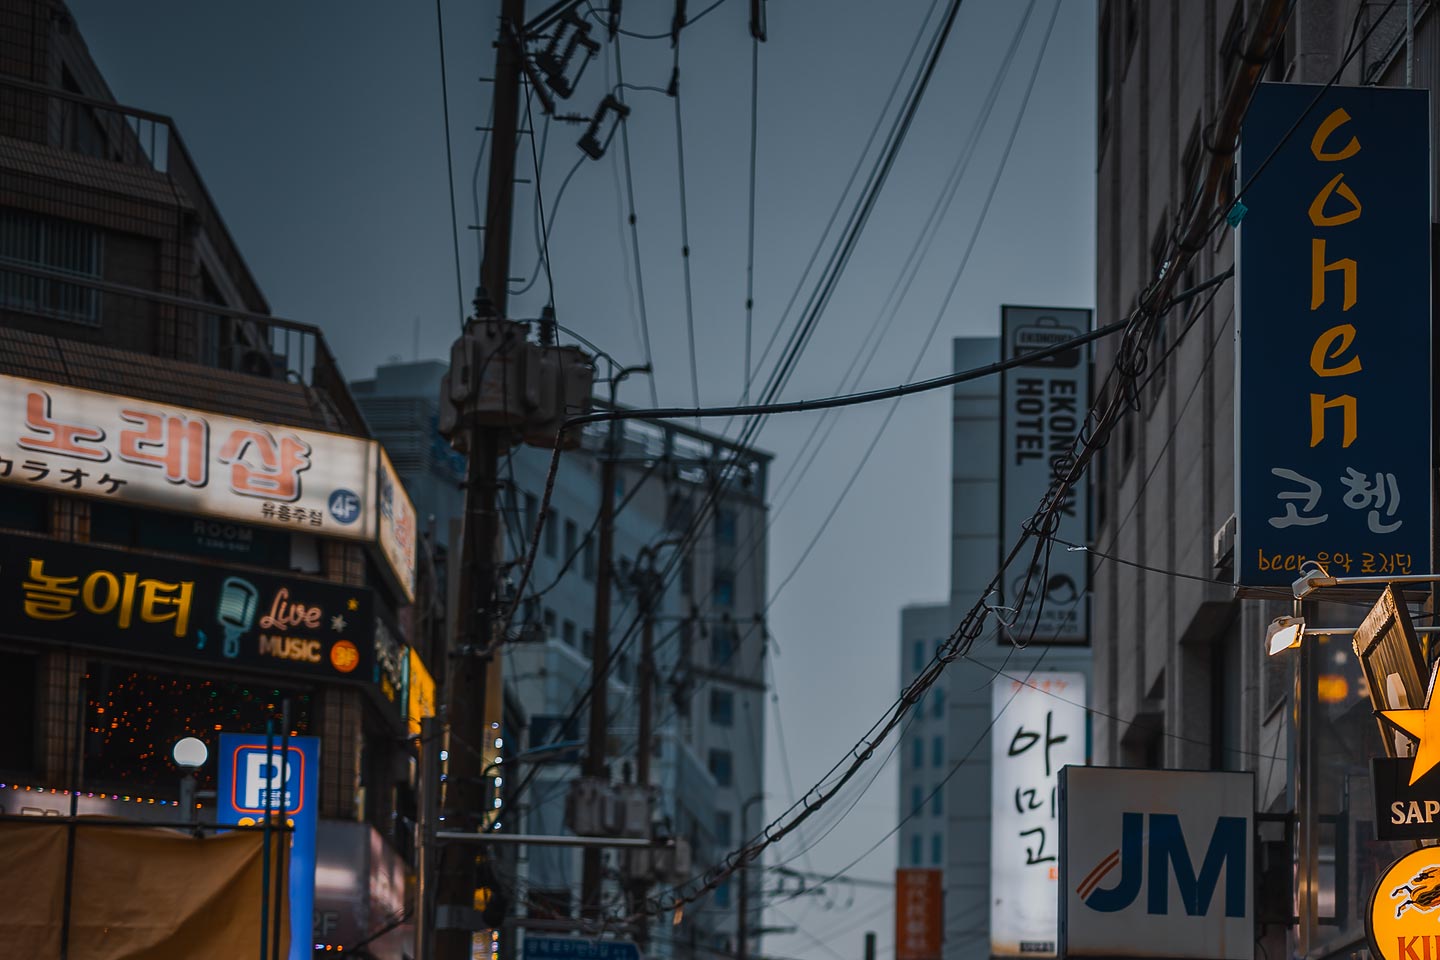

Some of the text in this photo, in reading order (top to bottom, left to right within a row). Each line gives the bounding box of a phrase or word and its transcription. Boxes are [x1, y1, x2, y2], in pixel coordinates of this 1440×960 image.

[17, 390, 311, 502] 노래샵
[1015, 378, 1044, 466] HOTEL
[330, 495, 358, 519] 4F
[1267, 466, 1403, 535] 코헨
[1258, 548, 1306, 571] beer
[21, 557, 196, 639] 놀이터
[258, 586, 323, 631] Live
[258, 633, 323, 663] MUSIC
[244, 752, 291, 808] P
[1078, 811, 1247, 918] JM
